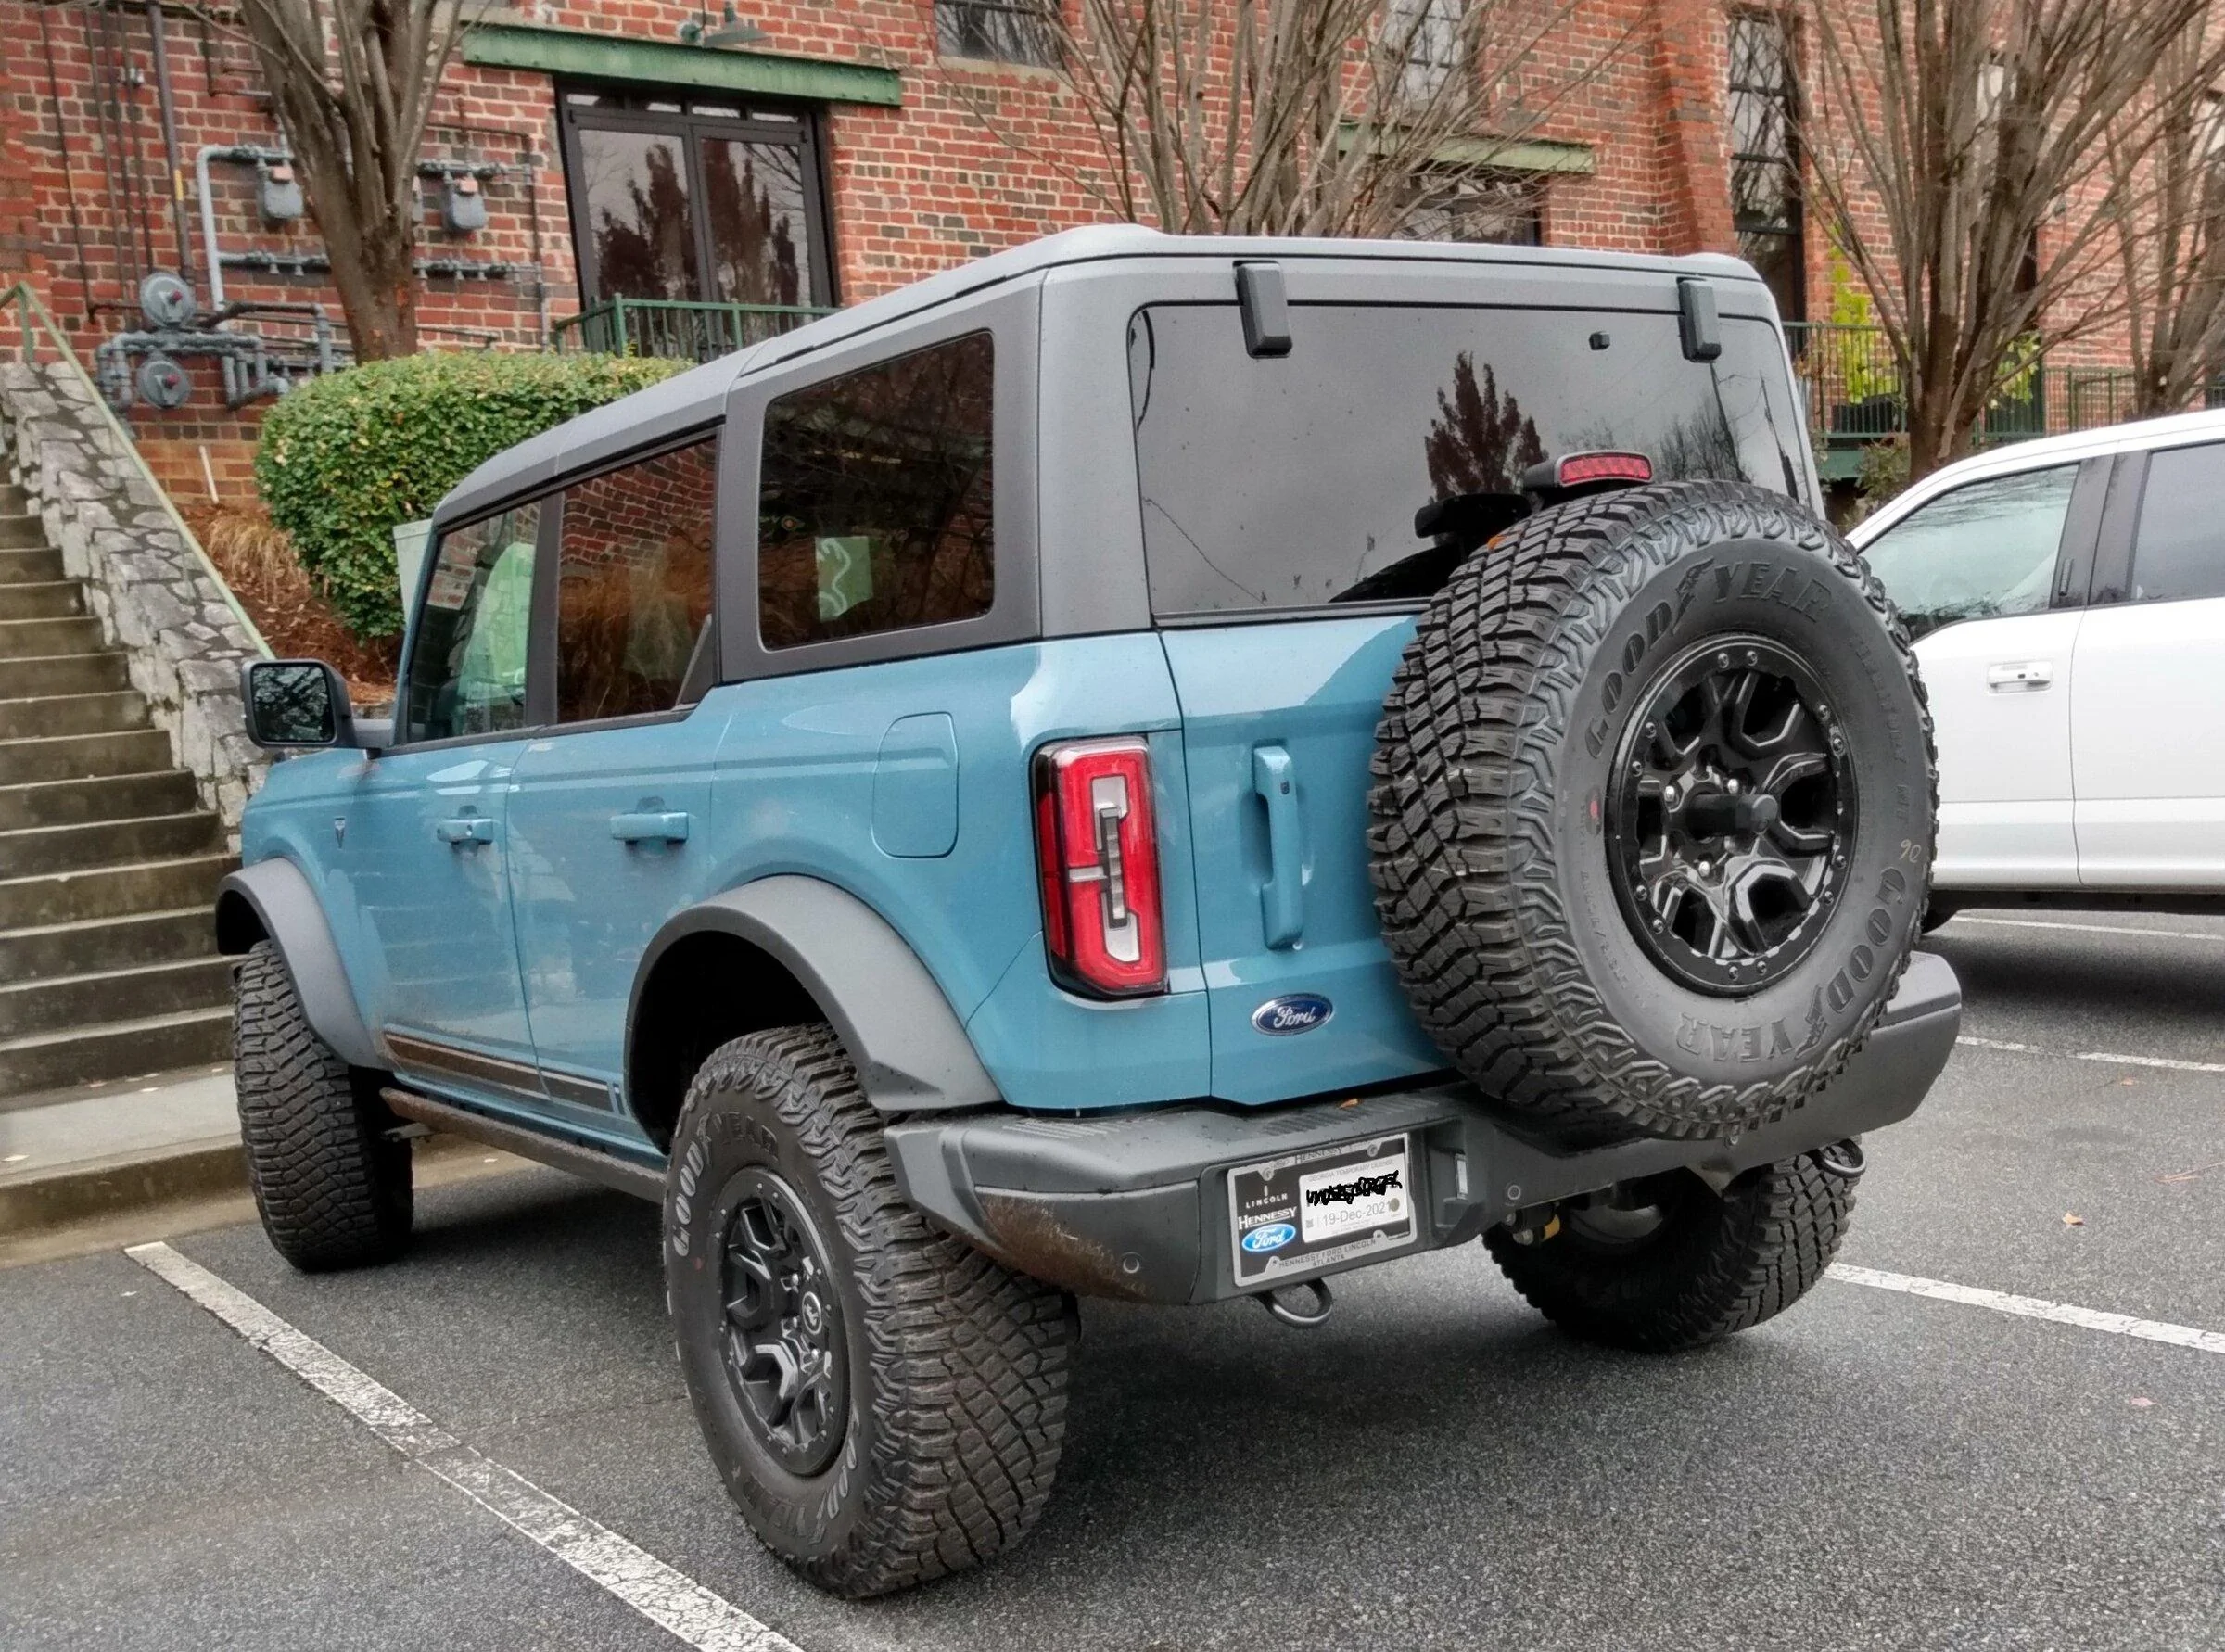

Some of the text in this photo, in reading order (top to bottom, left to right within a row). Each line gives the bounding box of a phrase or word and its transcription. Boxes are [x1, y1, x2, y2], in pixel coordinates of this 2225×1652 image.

[1273, 1005, 1316, 1027] Ford
[1245, 1193, 1289, 1209] LINCOLN
[1238, 1206, 1297, 1230] HENNESSY
[1252, 1228, 1285, 1249] Ford
[1278, 1252, 1320, 1269] HENNESSY
[1343, 1239, 1377, 1253] LINCOLN
